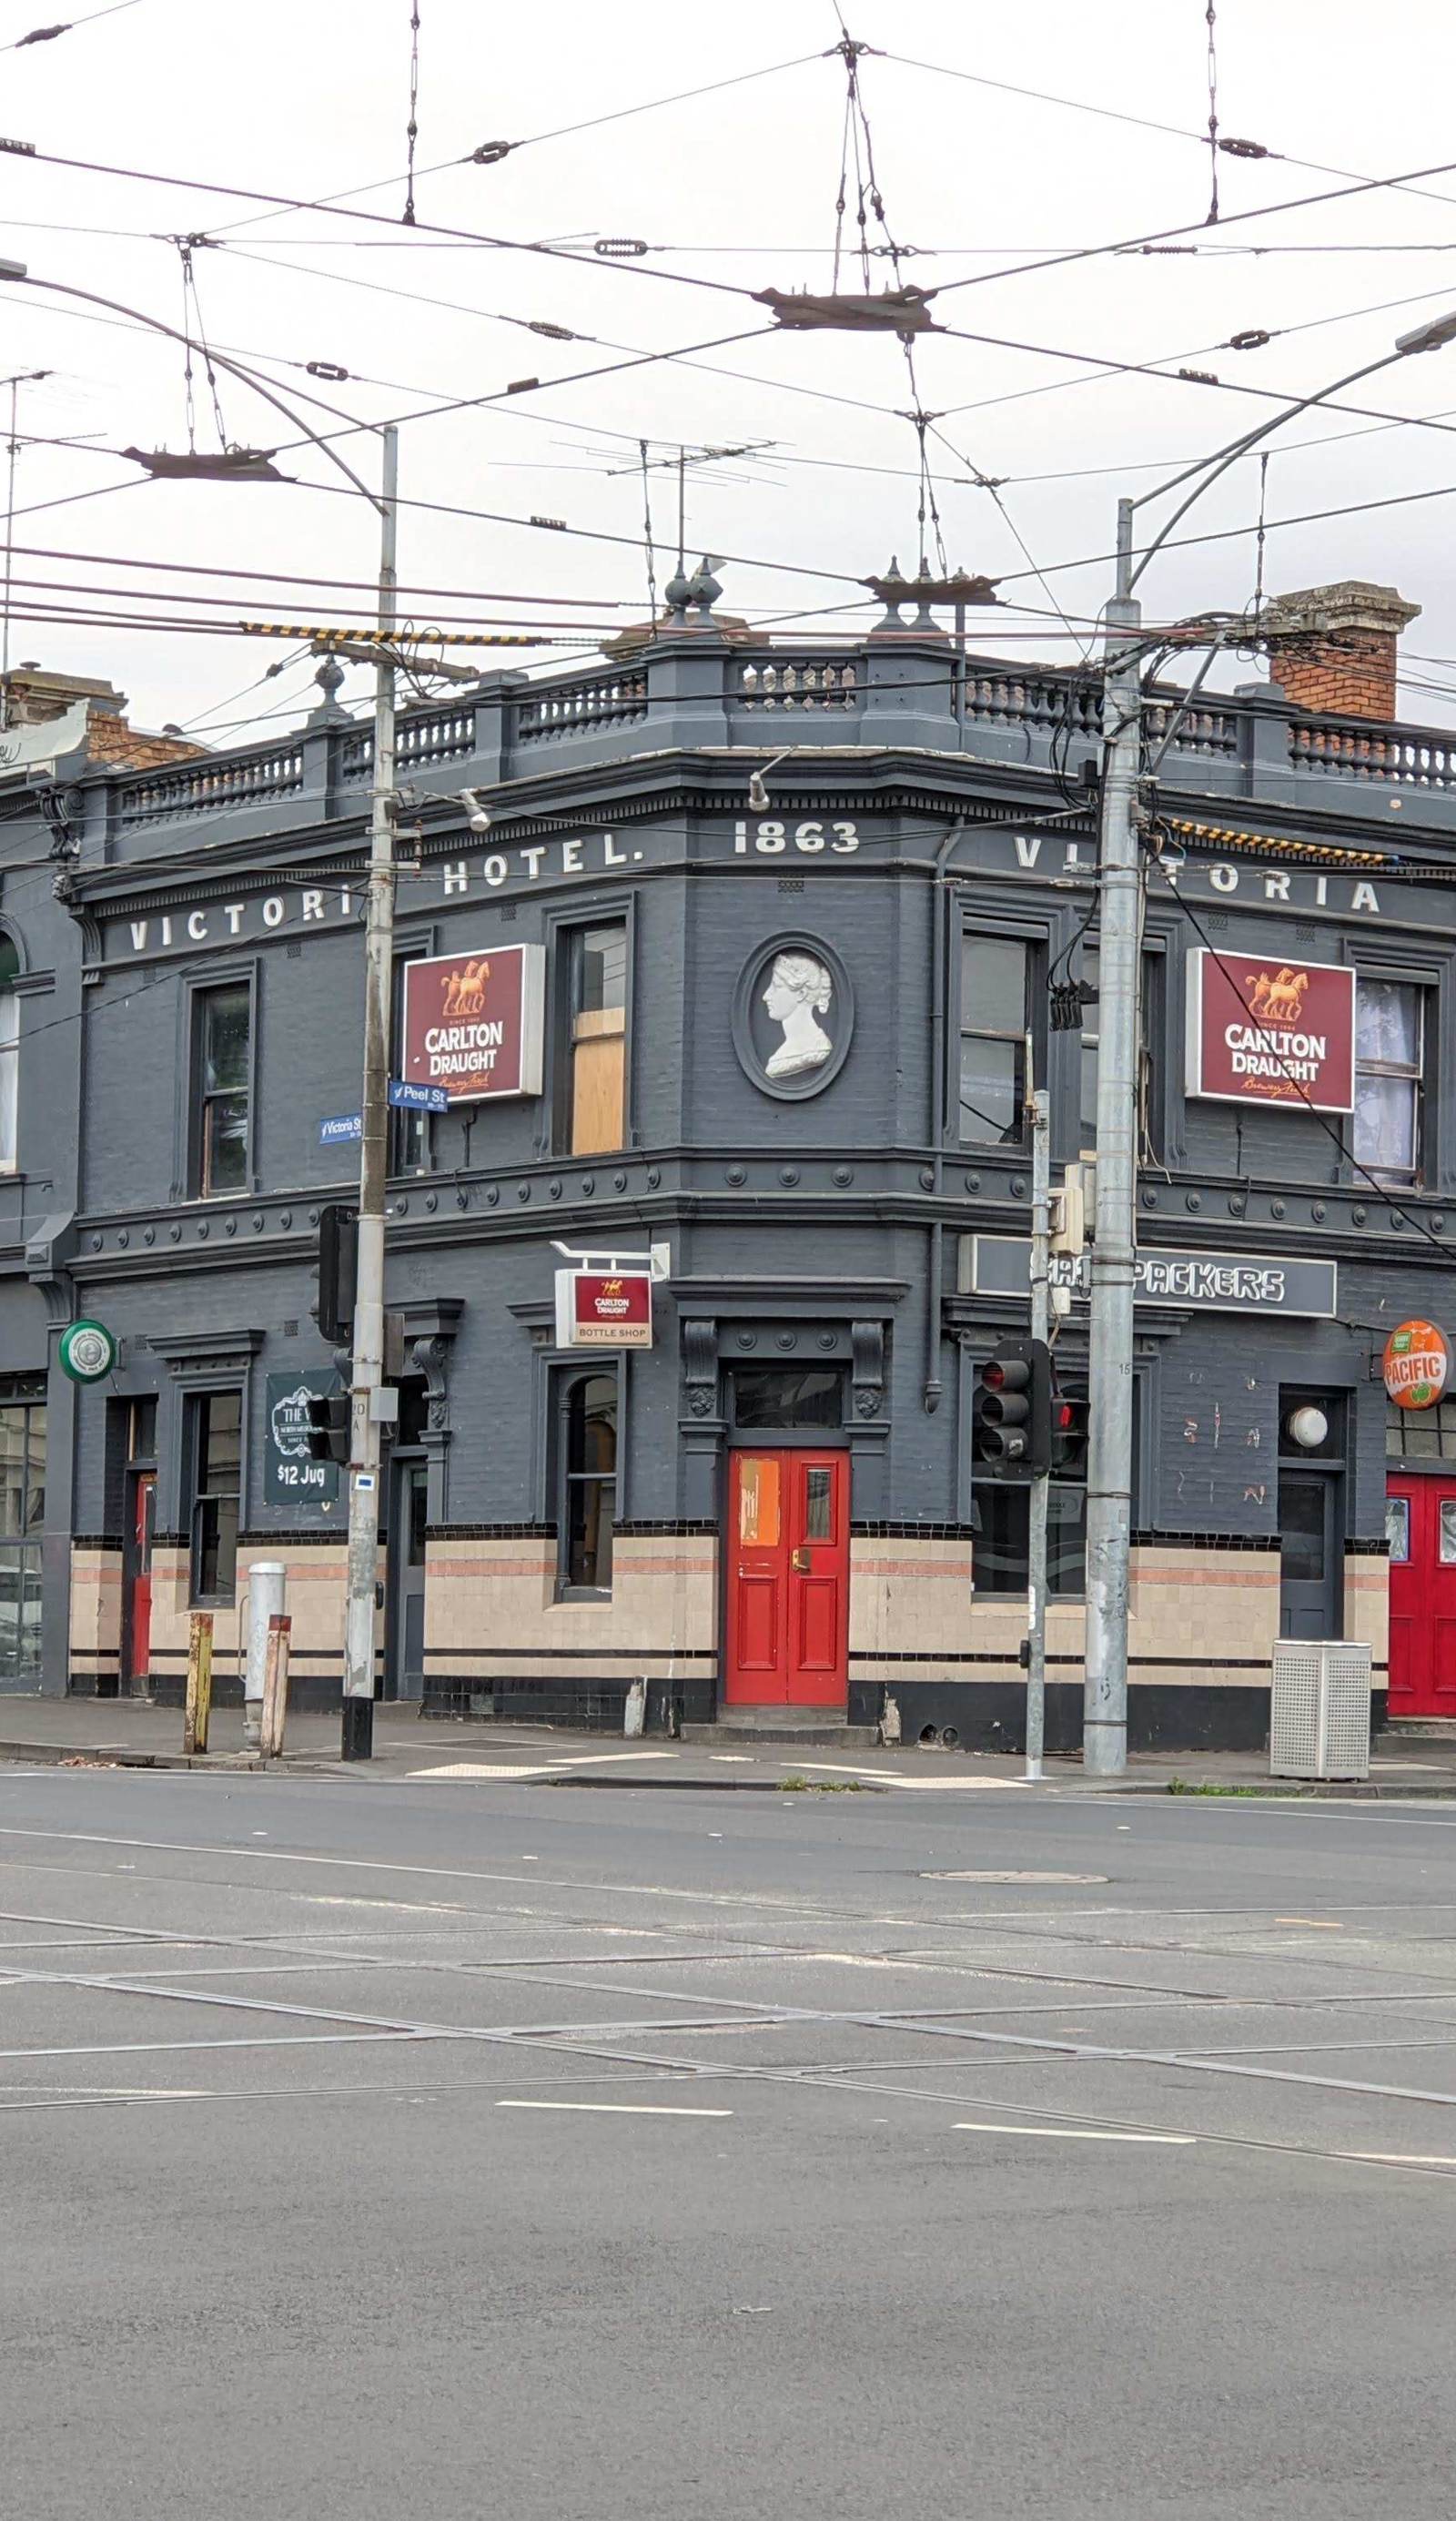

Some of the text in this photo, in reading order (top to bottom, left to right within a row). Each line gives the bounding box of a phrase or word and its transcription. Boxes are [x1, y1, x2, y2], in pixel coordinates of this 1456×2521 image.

[734, 821, 860, 854] 1863
[1014, 836, 1380, 913] VITORIA
[130, 884, 350, 950] VICTORI
[425, 1020, 503, 1054] CARLTON
[1224, 1023, 1327, 1060] CARLTON
[430, 1048, 498, 1077] DRAUGHT
[1231, 1051, 1320, 1082] DRAUGHT
[404, 1086, 445, 1104] Peel St
[327, 1119, 353, 1136] Victoria
[594, 1298, 630, 1307] CARLTON
[597, 1306, 627, 1314] DRAUGHT
[579, 1329, 646, 1338] BOTTLE SHOP
[1384, 1356, 1441, 1385] PACIFIC
[282, 1408, 303, 1422] THE
[278, 1463, 326, 1488] $12 Jug
